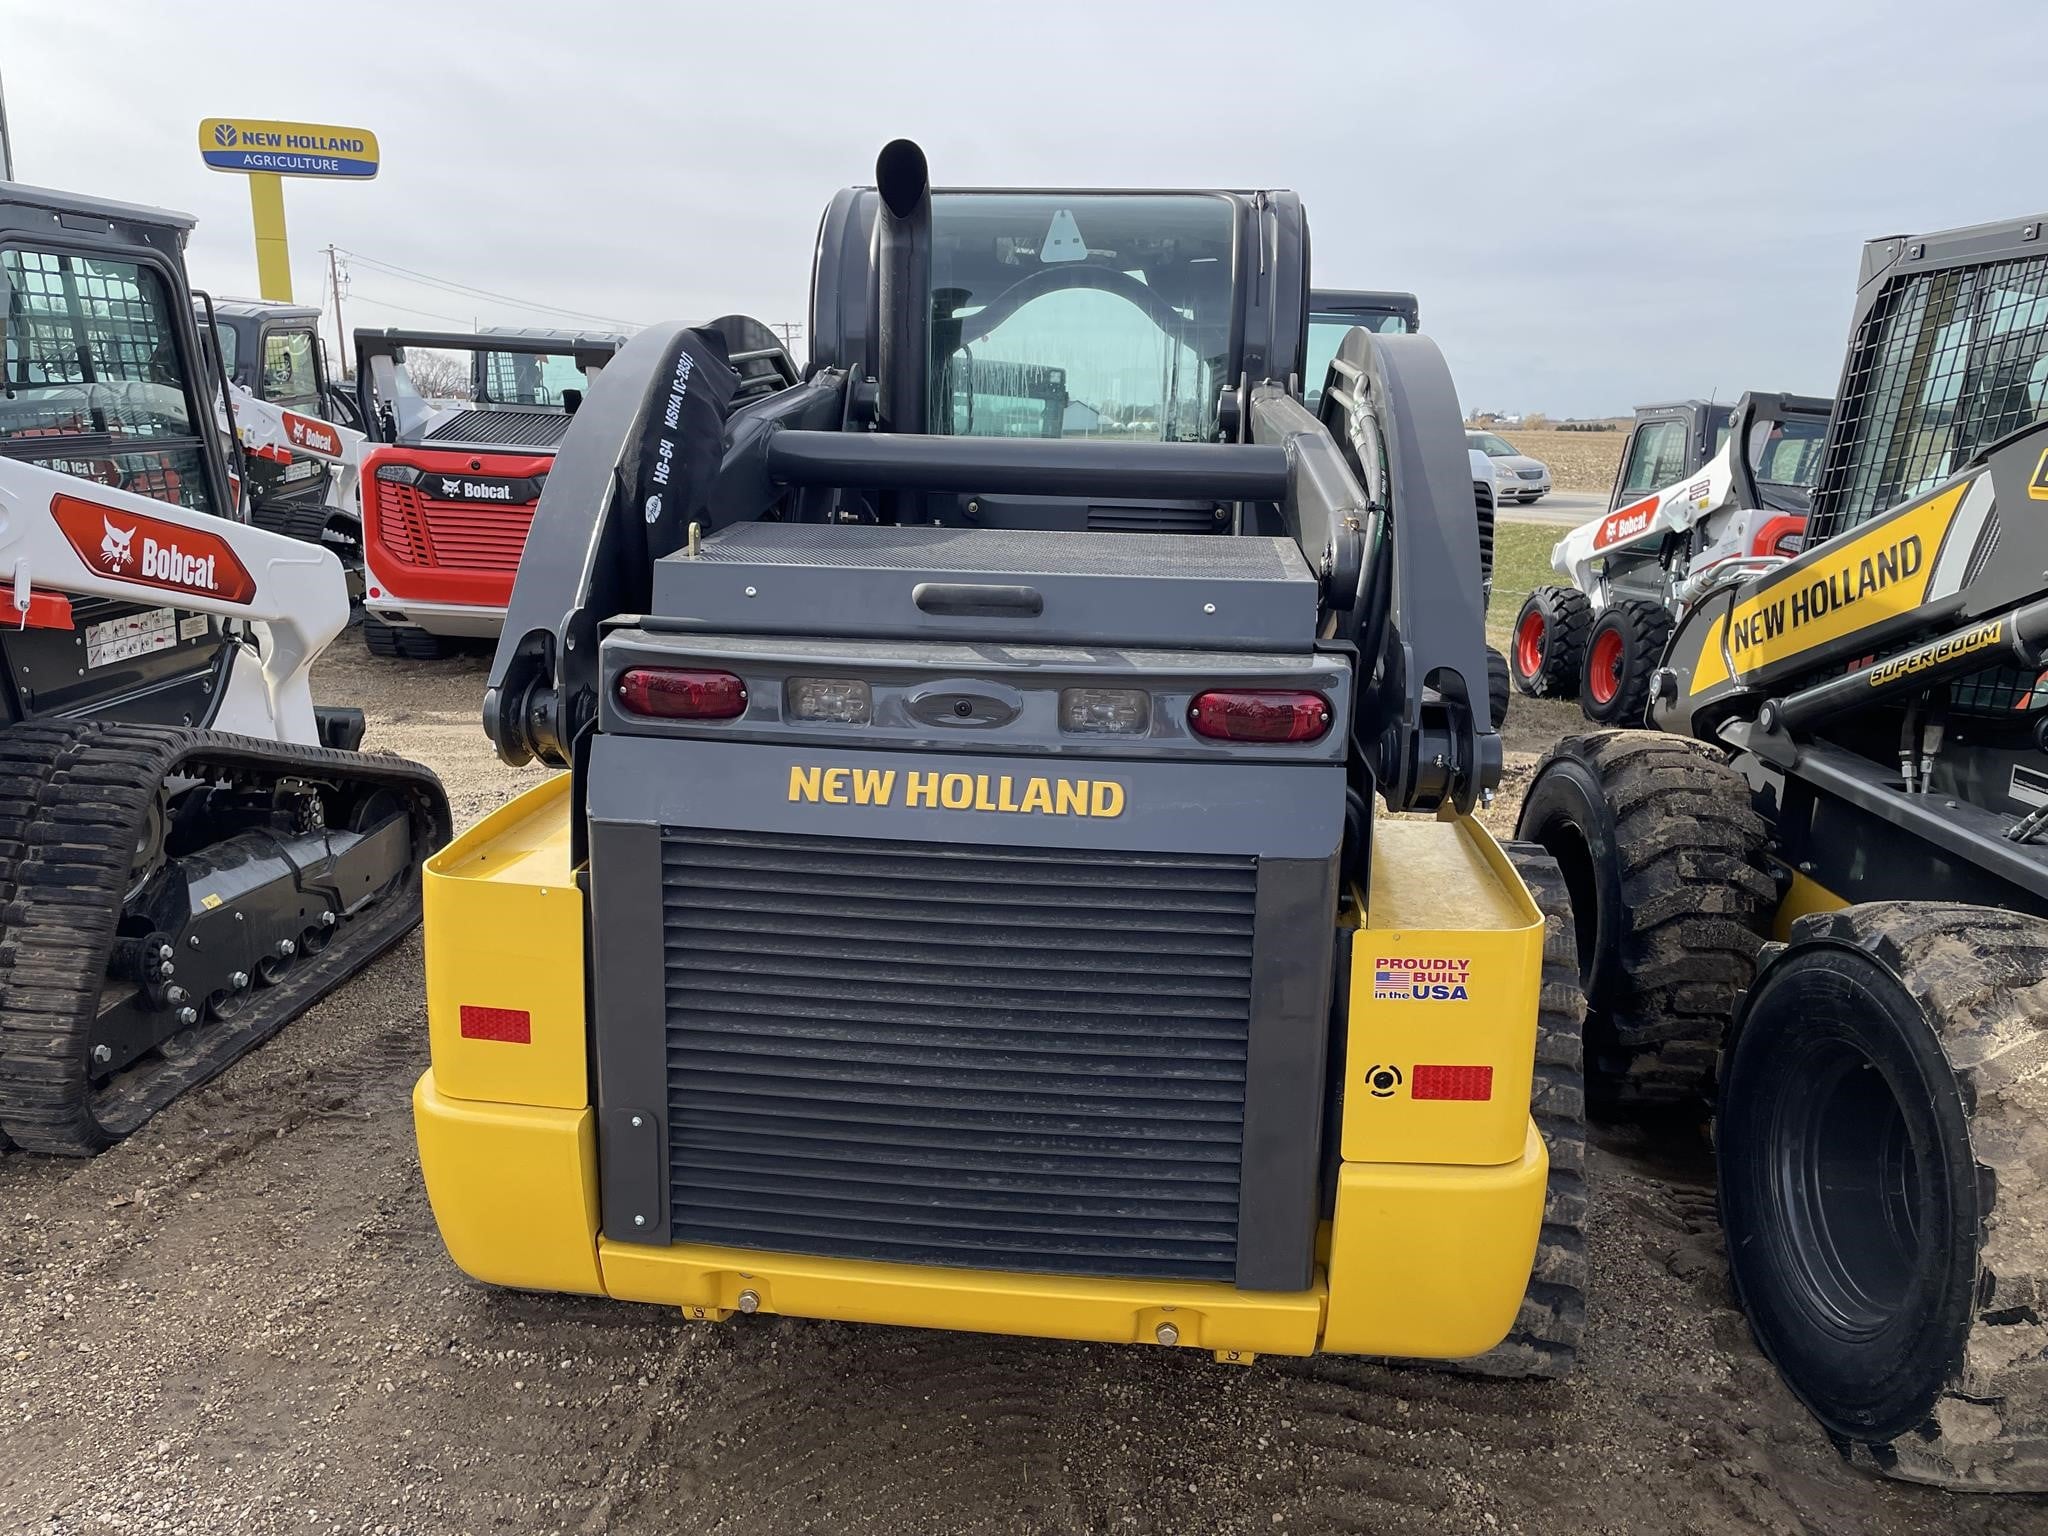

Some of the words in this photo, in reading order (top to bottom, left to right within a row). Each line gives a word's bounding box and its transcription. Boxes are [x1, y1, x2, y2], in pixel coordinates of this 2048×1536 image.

[242, 131, 282, 147] NEW
[286, 134, 364, 153] HOLLAND
[243, 154, 339, 171] AGRICULTURE
[306, 428, 332, 451] Bobcat
[652, 438, 675, 486] HG-64
[664, 393, 684, 430] MSHA
[464, 482, 511, 500] Bobcat
[1619, 510, 1648, 538] Bobcat
[141, 537, 216, 591] Bobcat
[1734, 599, 1785, 654] NEW
[1791, 533, 1923, 630] HOLLAND
[788, 765, 897, 806] NEW
[905, 771, 1126, 818] HOLLAND
[1376, 958, 1471, 970] PROUDLY
[1412, 971, 1470, 984] BUILT
[1375, 990, 1387, 999] in
[1389, 991, 1410, 1000] the
[1412, 985, 1468, 1000] USA
